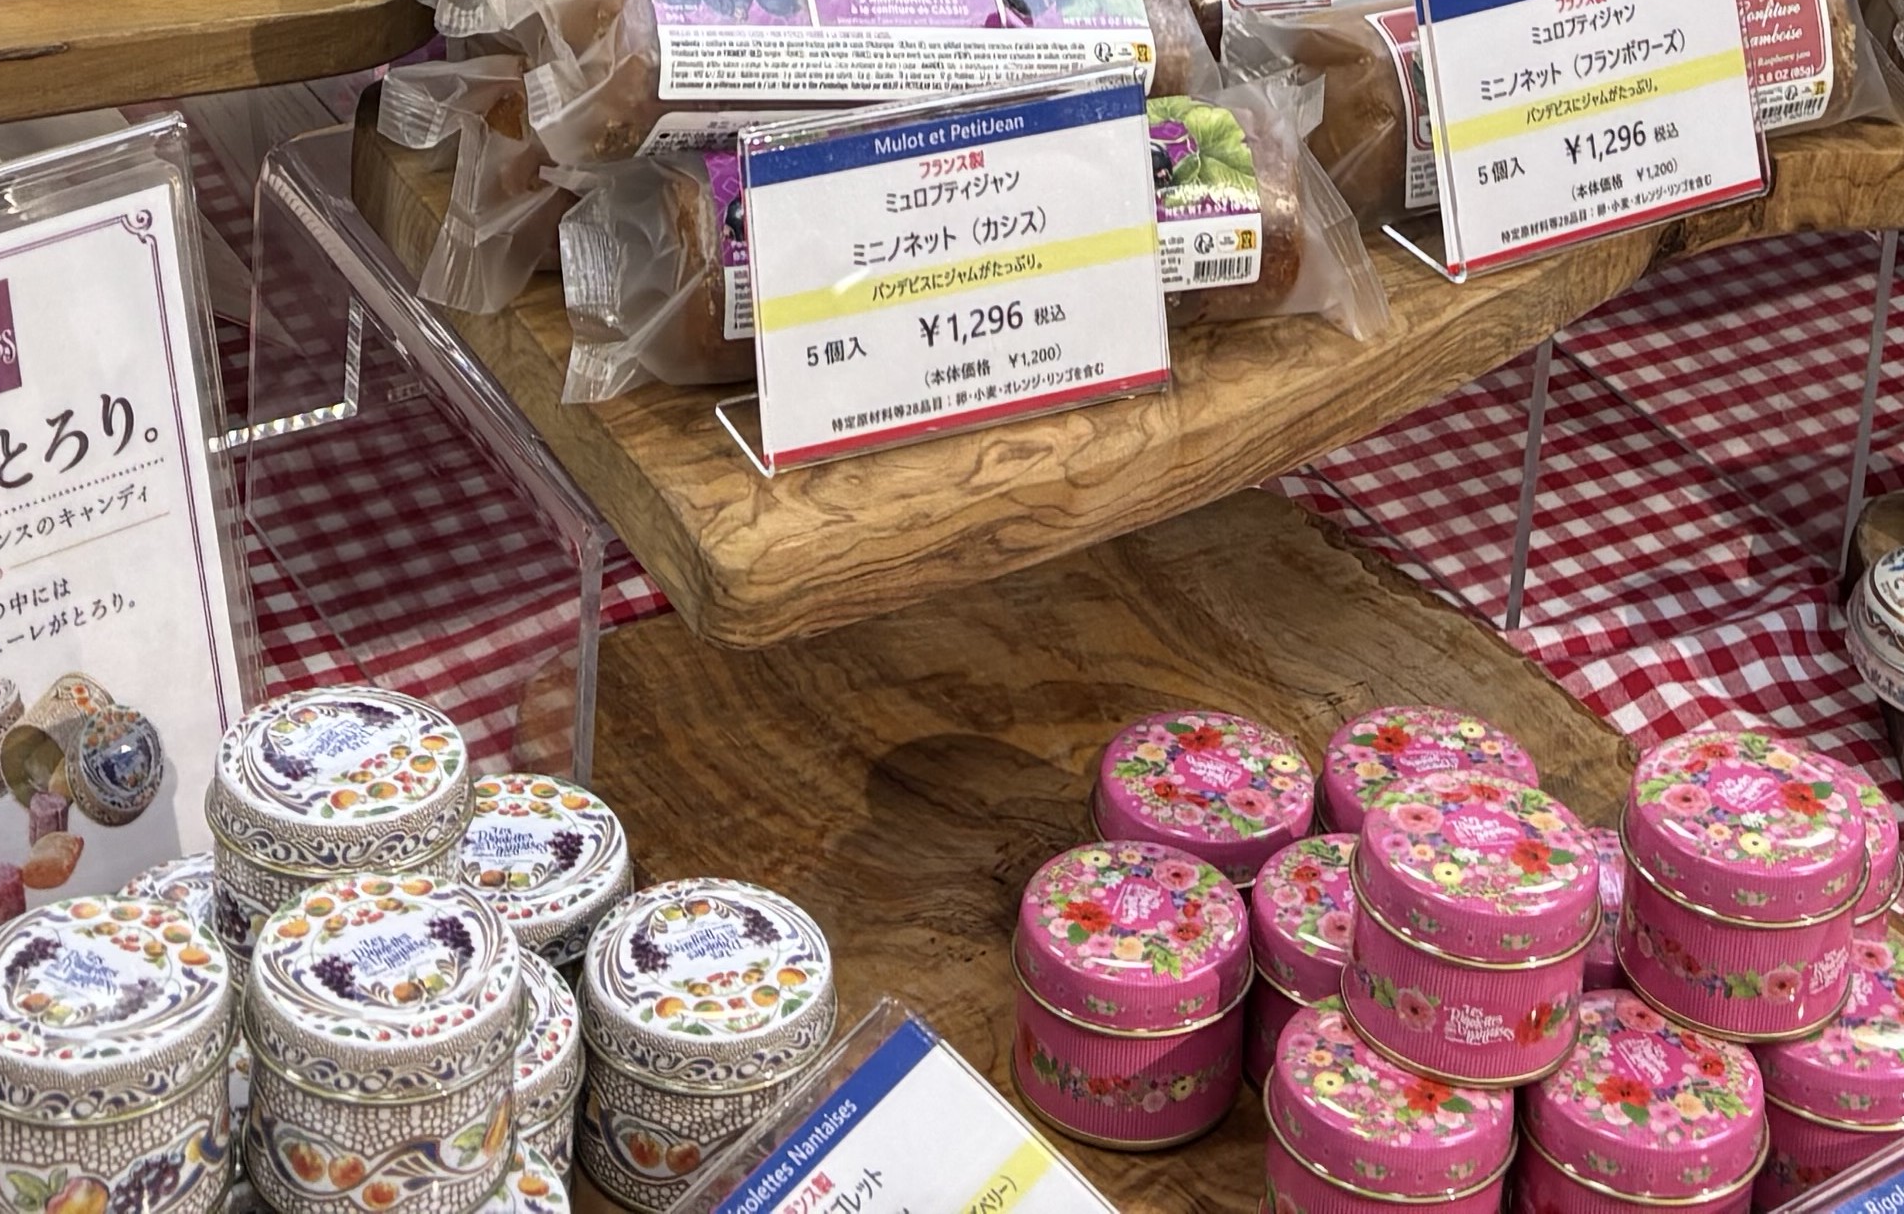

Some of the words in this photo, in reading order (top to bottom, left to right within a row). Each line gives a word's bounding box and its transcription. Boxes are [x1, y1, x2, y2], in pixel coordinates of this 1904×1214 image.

[1481, 28, 1686, 101] ミニノネット（フランボワーズ）
[1527, 78, 1659, 125] パンデピスにジャムがたっぷり。
[874, 133, 925, 157] Mulot
[930, 130, 945, 145] et
[950, 115, 1024, 142] PetitJean
[1564, 121, 1647, 166] ¥1,296
[1654, 123, 1679, 143] 税込
[919, 150, 985, 179] フランス製
[1478, 156, 1526, 186] ５個入
[853, 205, 1047, 267] ミニノネット（カシス）
[872, 252, 1043, 302] パンデピスにジャムがたっぷり。
[919, 301, 1024, 348] ¥1,296
[1034, 304, 1066, 325] 税込
[807, 336, 867, 367] ５個入
[791, 1097, 859, 1169] Nantaises
